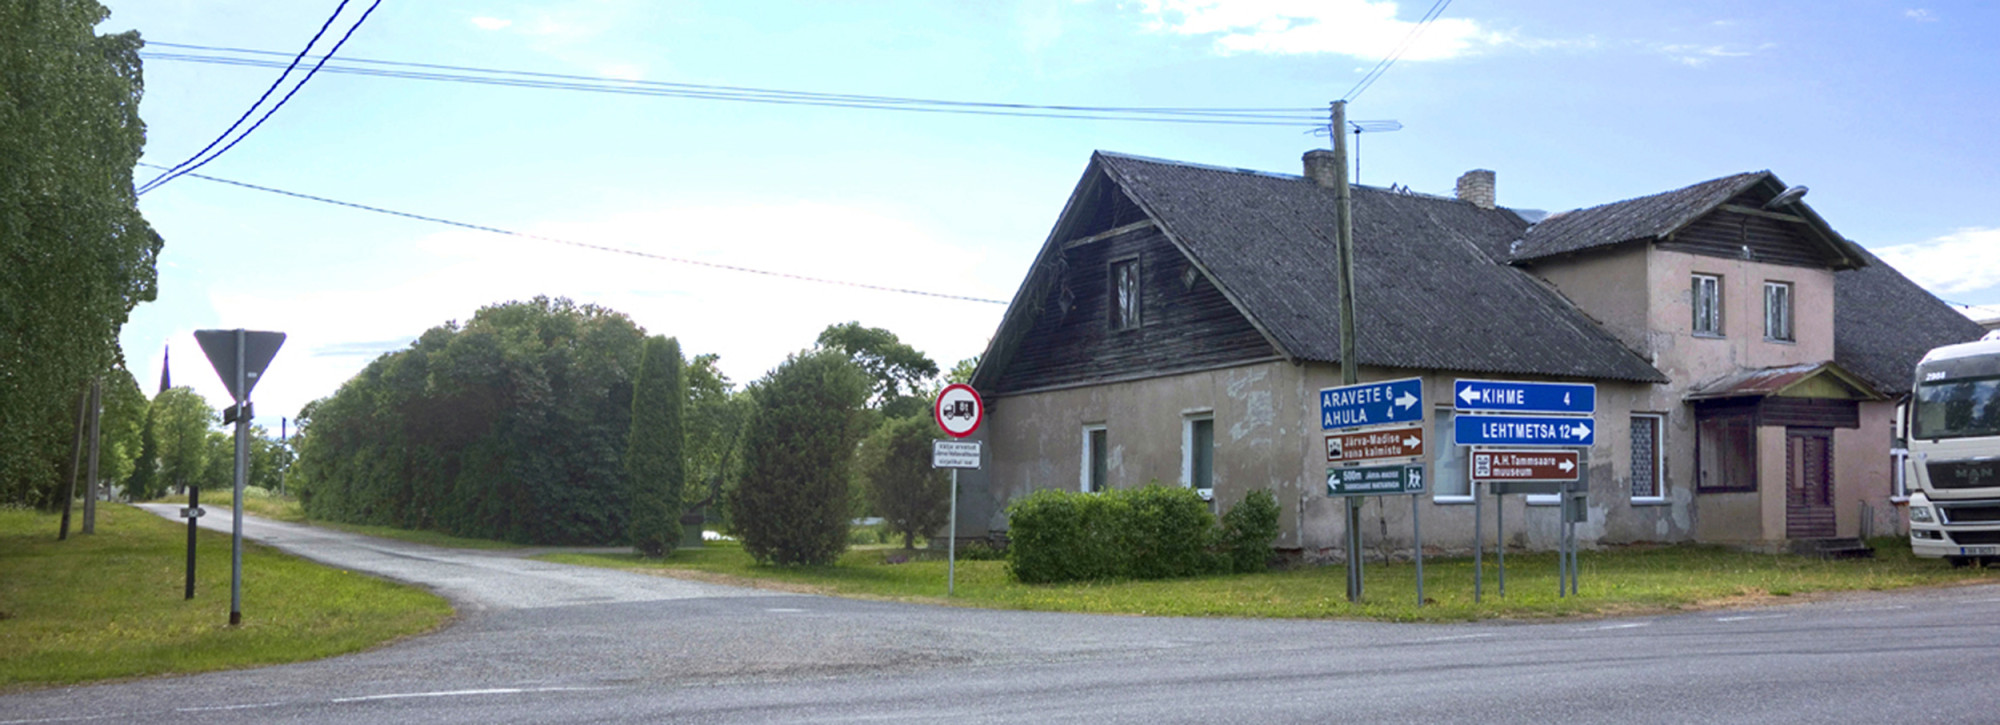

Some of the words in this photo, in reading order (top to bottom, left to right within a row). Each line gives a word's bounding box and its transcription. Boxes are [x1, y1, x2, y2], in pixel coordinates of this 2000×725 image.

[1323, 387, 1380, 407] ARAVETE
[1385, 386, 1393, 400] 6
[1482, 388, 1525, 405] KIHME
[1563, 391, 1570, 406] 4
[1324, 408, 1367, 426] AHULA
[1387, 406, 1394, 419] 4
[1482, 422, 1556, 438] LEHTMETSA
[1559, 424, 1571, 439] 12
[1344, 433, 1400, 447] Järva-Madise
[1344, 448, 1363, 459] vana
[1364, 445, 1402, 457] kalmistu
[1493, 468, 1532, 477] muuseum
[1955, 467, 1993, 477] MAN
